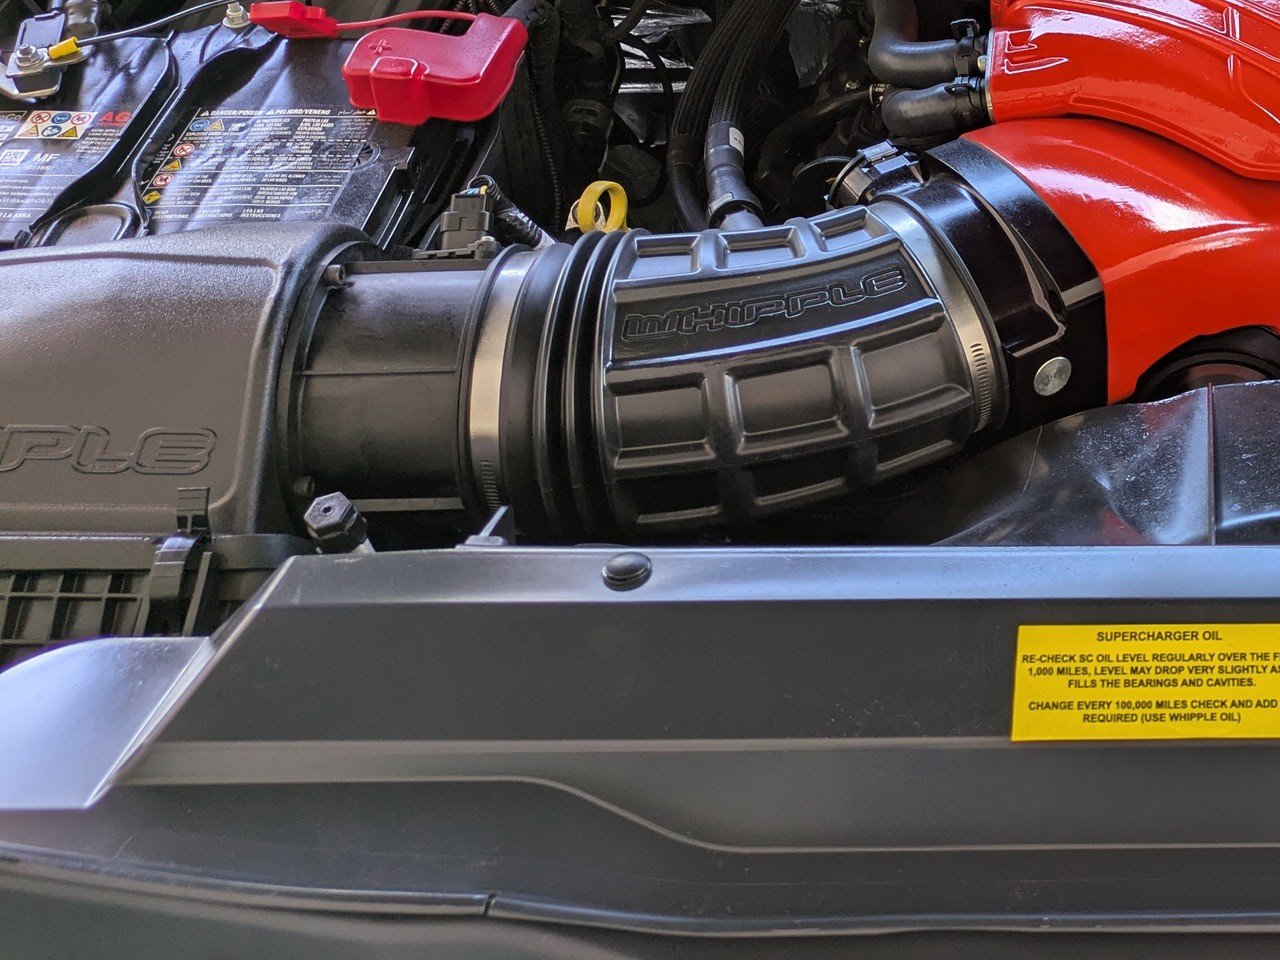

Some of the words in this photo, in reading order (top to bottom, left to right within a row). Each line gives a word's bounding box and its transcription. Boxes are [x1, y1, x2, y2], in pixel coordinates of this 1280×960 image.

[32, 153, 60, 162] MF
[621, 266, 908, 341] WHIPPLE
[1096, 631, 1200, 642] SUPERCHARGER
[1202, 631, 1221, 641] OIL
[1021, 654, 1077, 664] RE-CHECK
[1078, 654, 1094, 663] SC
[1096, 654, 1113, 663] OIL
[1115, 654, 1148, 663] LEVEL
[1151, 653, 1216, 662] REGULARLY
[1217, 652, 1248, 662] OVER
[1250, 652, 1271, 662] THE
[1028, 667, 1055, 677] 1,000
[1056, 667, 1092, 677] MILES,
[1093, 666, 1127, 675] LEVEL
[1129, 666, 1152, 675] MAY
[1154, 666, 1185, 675] DROP
[1187, 666, 1216, 674] VERY
[1217, 665, 1268, 674] SLIGHTLY
[1067, 680, 1098, 688] FILLS
[1100, 679, 1121, 688] THE
[1123, 679, 1179, 688] BEARINGS
[1180, 679, 1204, 688] AND
[1206, 678, 1257, 687] CAVITIES.
[1028, 701, 1075, 710] CHANGE
[1076, 701, 1112, 710] EVERY
[1115, 700, 1154, 711] 100,000
[1155, 700, 1188, 710] MILES
[1190, 700, 1228, 709] CHECK
[1230, 700, 1254, 709] AND
[1255, 699, 1279, 709] ADD
[1082, 714, 1139, 722] REQUIRED
[1140, 714, 1167, 724] (USE
[1168, 713, 1218, 722] WHIPPLE
[1219, 713, 1242, 723] OIL)
